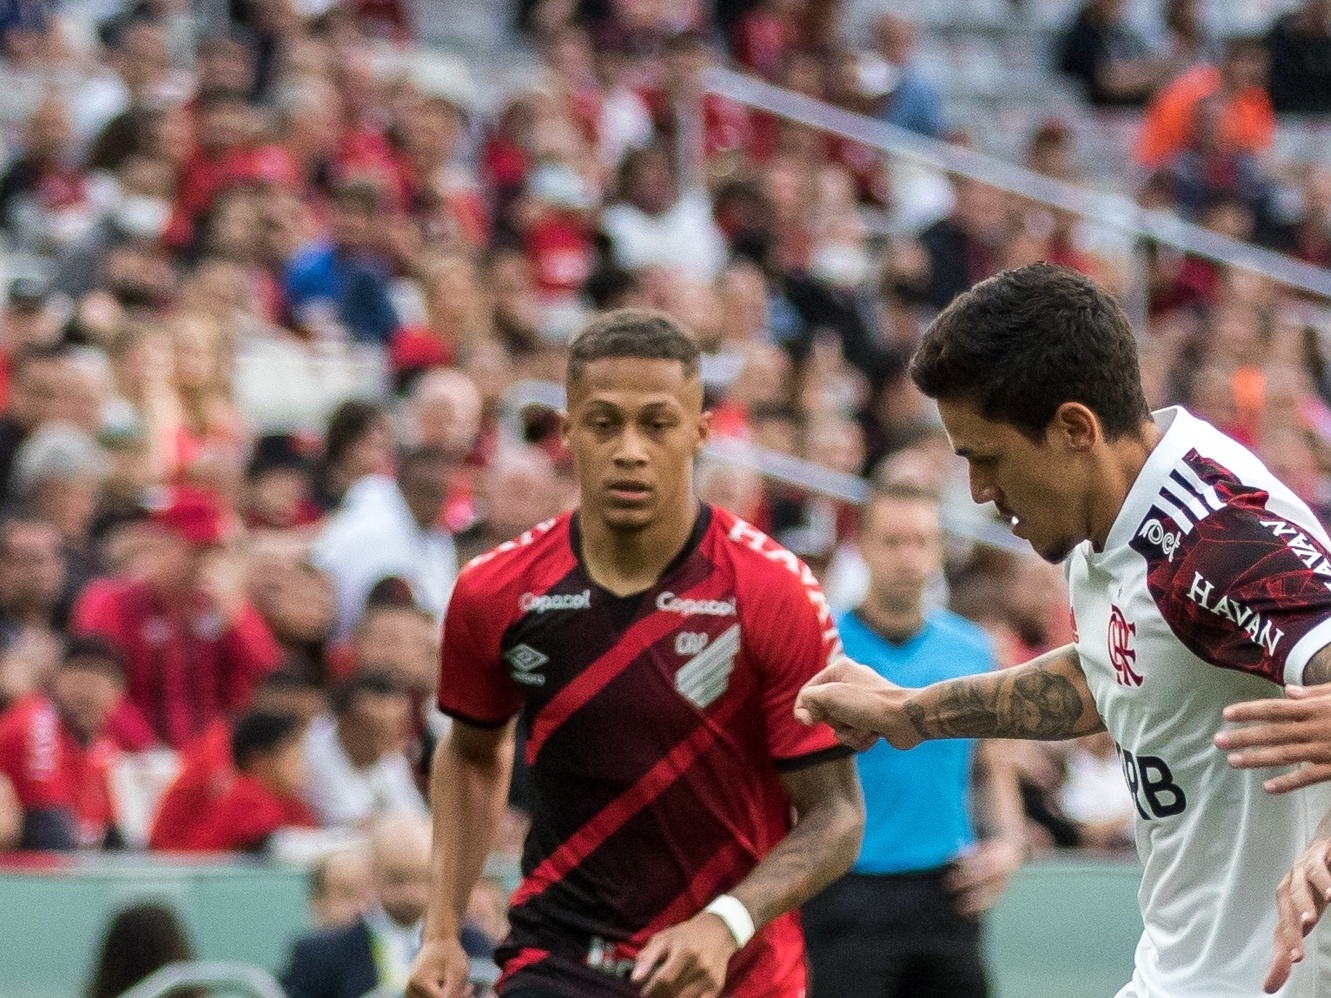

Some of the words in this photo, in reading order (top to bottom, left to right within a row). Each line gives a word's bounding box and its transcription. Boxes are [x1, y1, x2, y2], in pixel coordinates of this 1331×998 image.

[518, 589, 591, 614] Copacol
[656, 590, 737, 616] Copacol
[1186, 570, 1285, 657] HAVAN
[1115, 741, 1187, 821] RB
